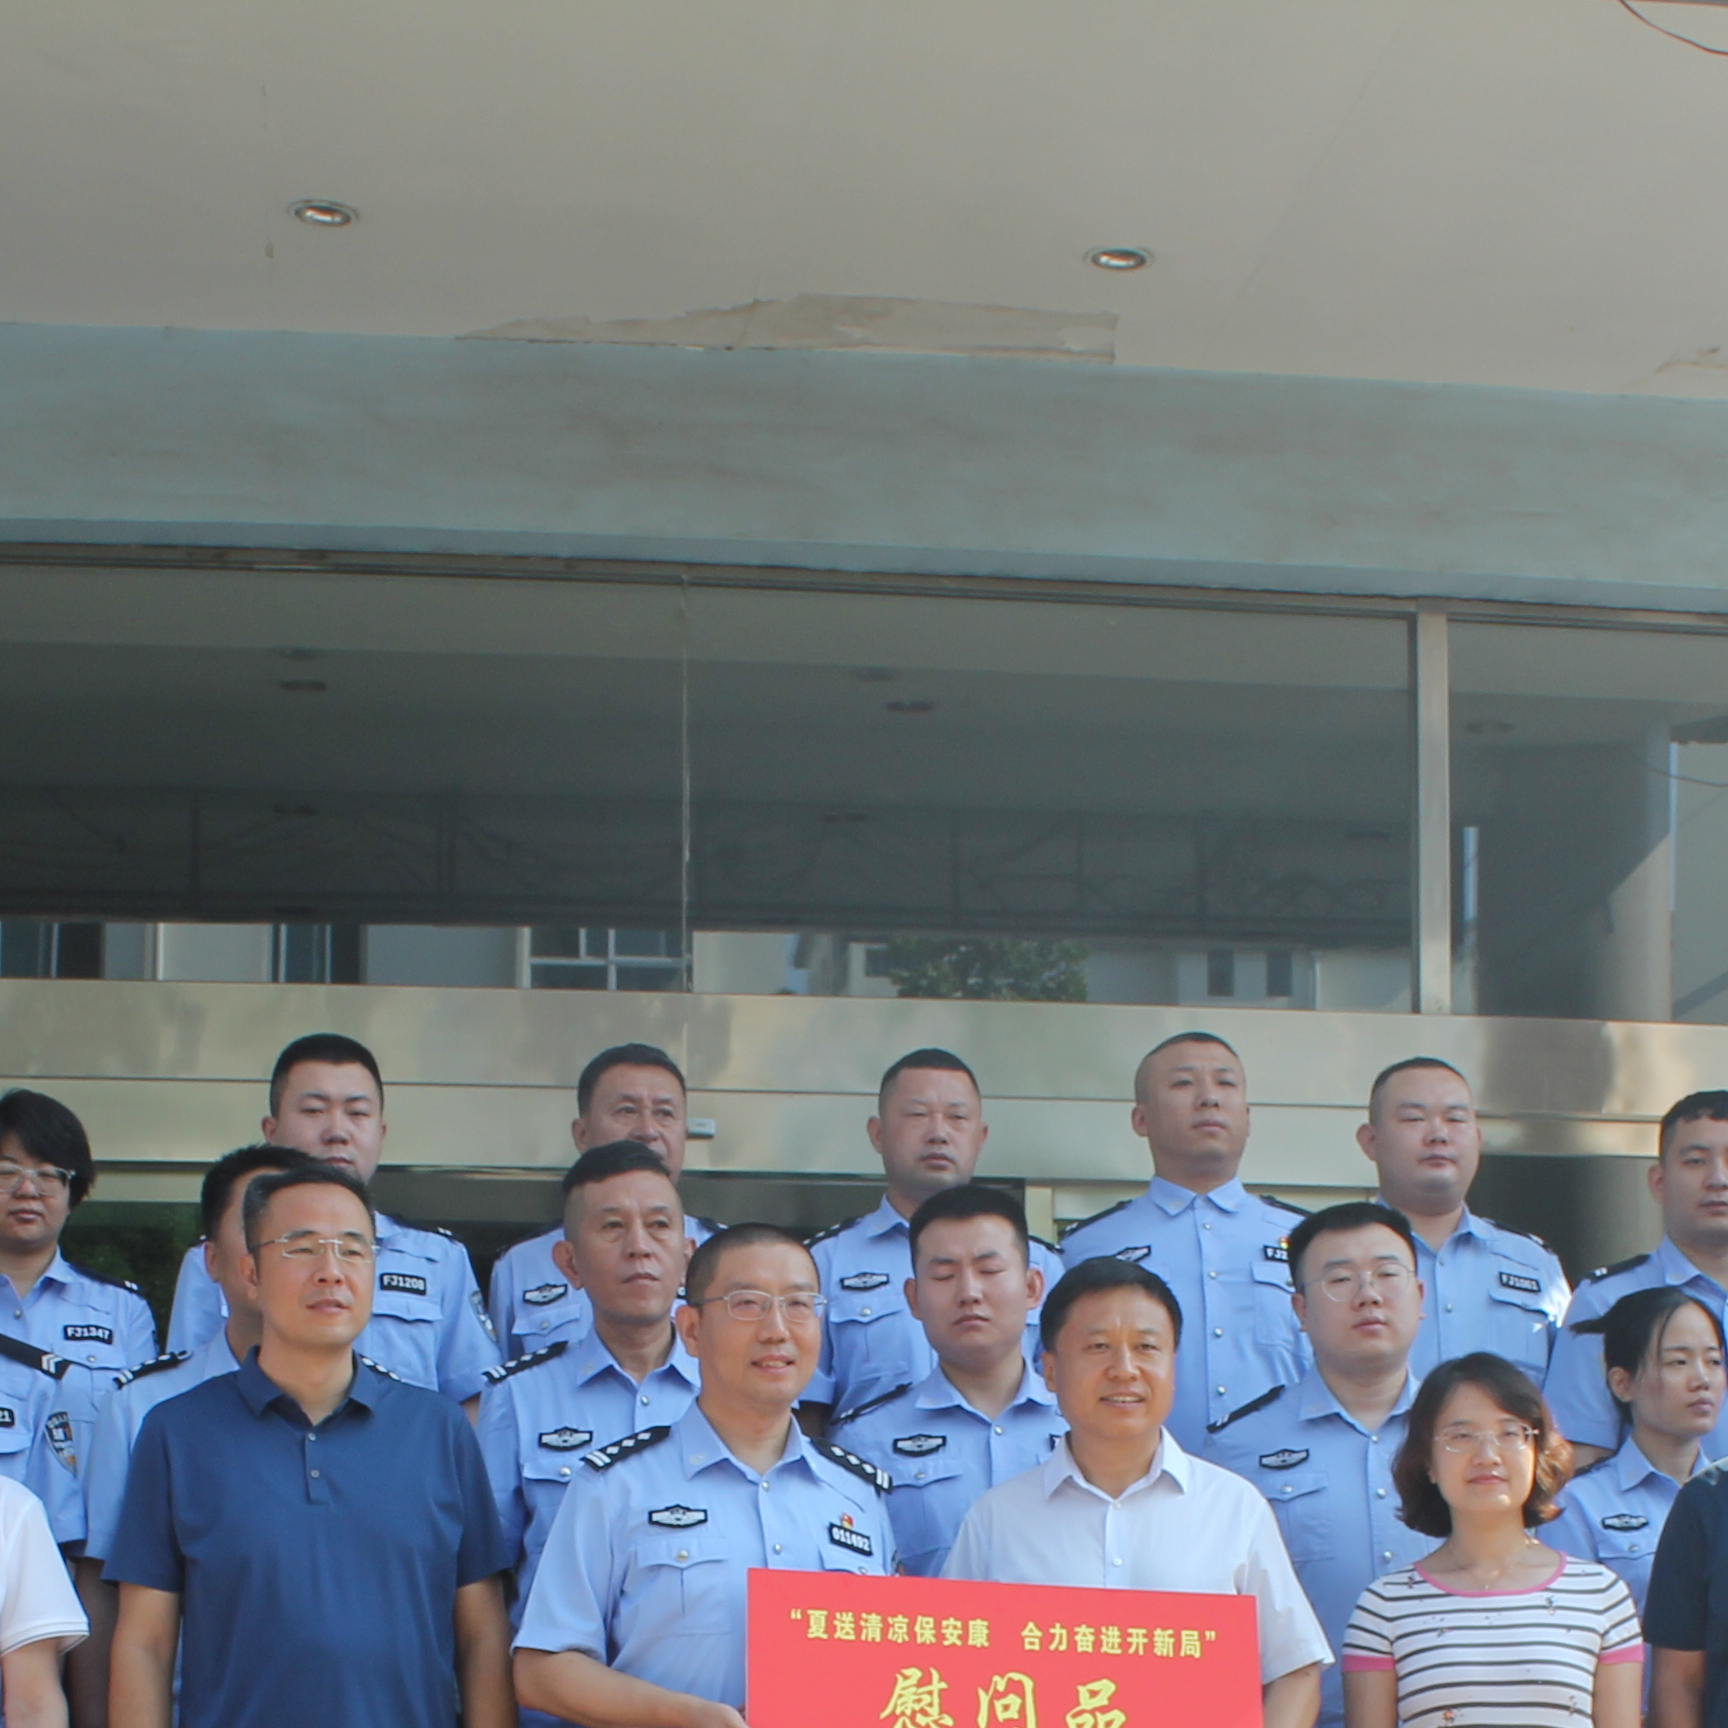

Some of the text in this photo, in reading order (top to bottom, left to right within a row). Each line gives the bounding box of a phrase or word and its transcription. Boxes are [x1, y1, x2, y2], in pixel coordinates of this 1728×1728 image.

[66, 1326, 110, 1340] FJ1347
[789, 1609, 1216, 1659] “夏送清凉保安康 合力奋进开新局”
